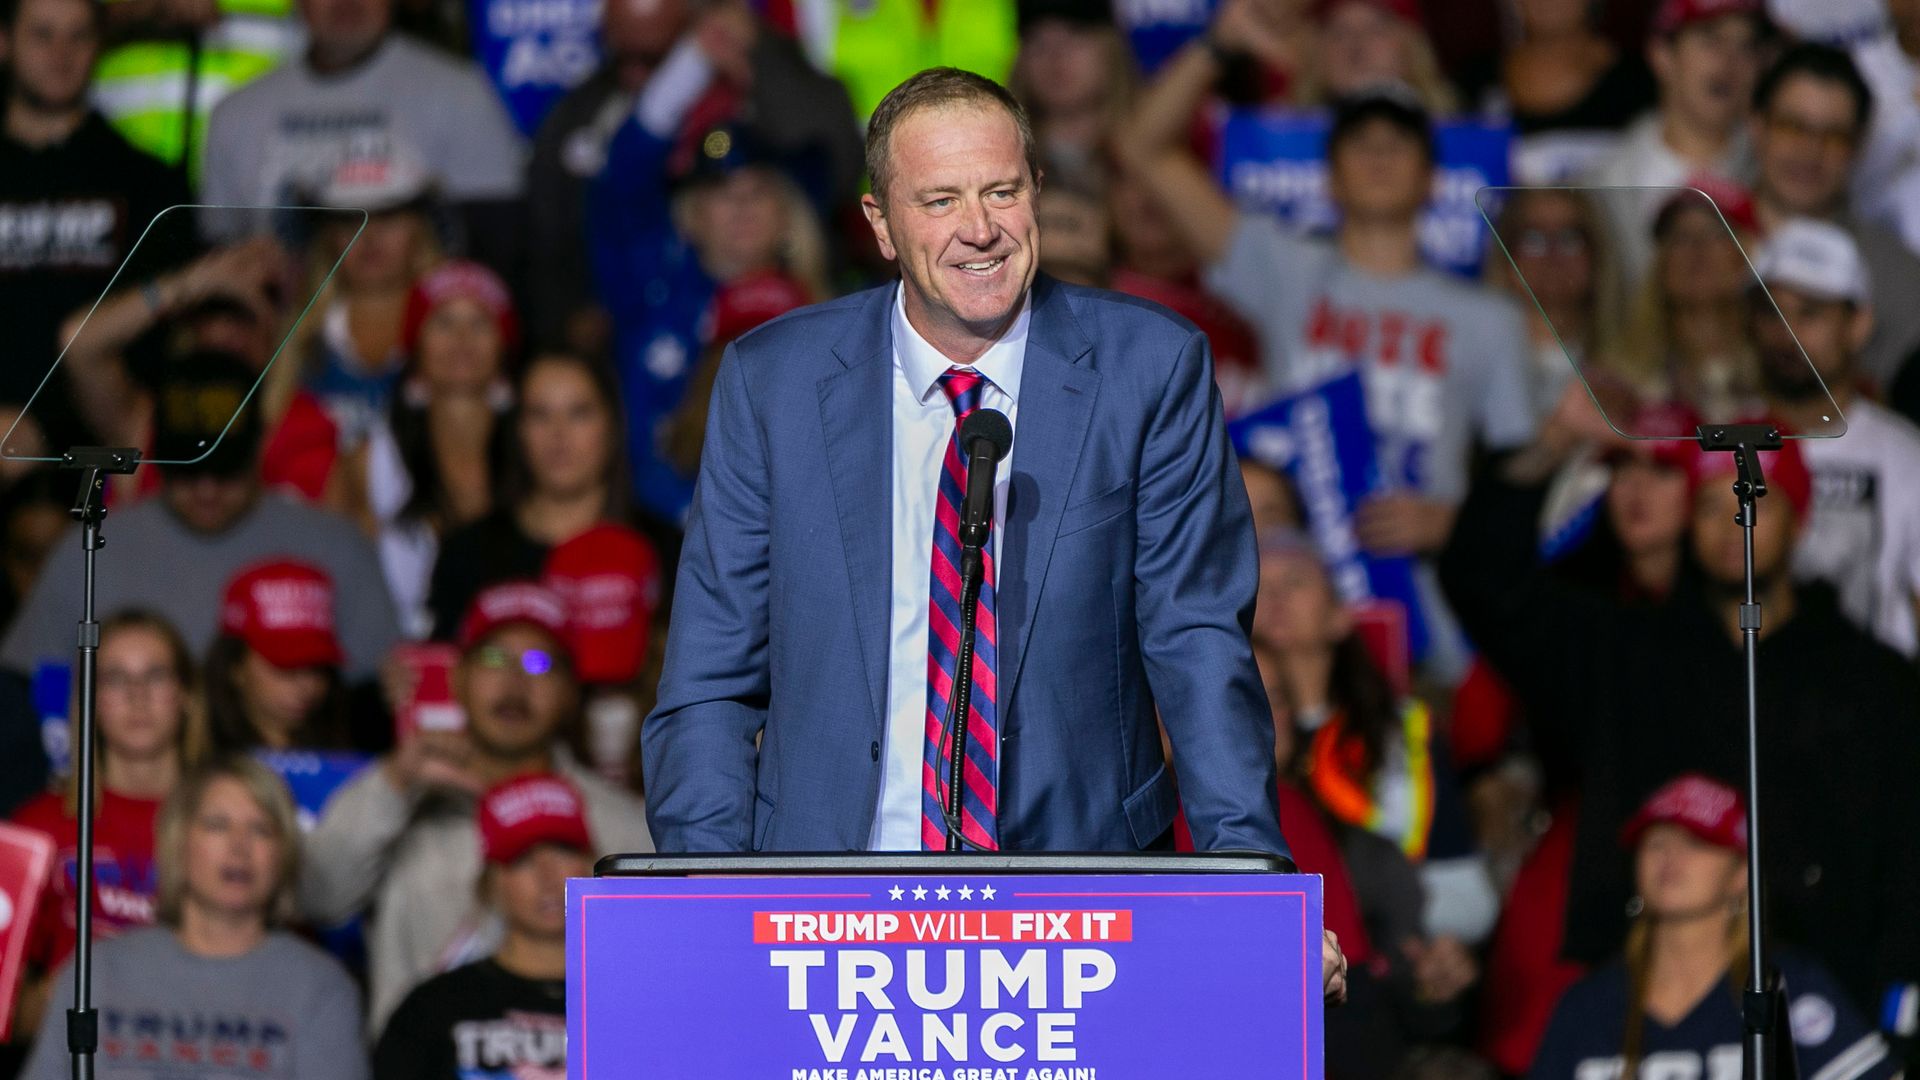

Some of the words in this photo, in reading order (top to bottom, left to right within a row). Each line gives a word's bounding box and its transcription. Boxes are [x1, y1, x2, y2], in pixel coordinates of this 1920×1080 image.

[769, 913, 900, 941] TRUMP
[909, 912, 1001, 941] WILL
[1012, 912, 1072, 940] FIX
[1082, 912, 1117, 940] IT
[769, 949, 1117, 1010] TRUMP
[808, 1012, 1077, 1063] VANCE
[792, 1068, 849, 1080] MAKE
[854, 1068, 946, 1080] AMERICA
[952, 1067, 1019, 1080] GREAT
